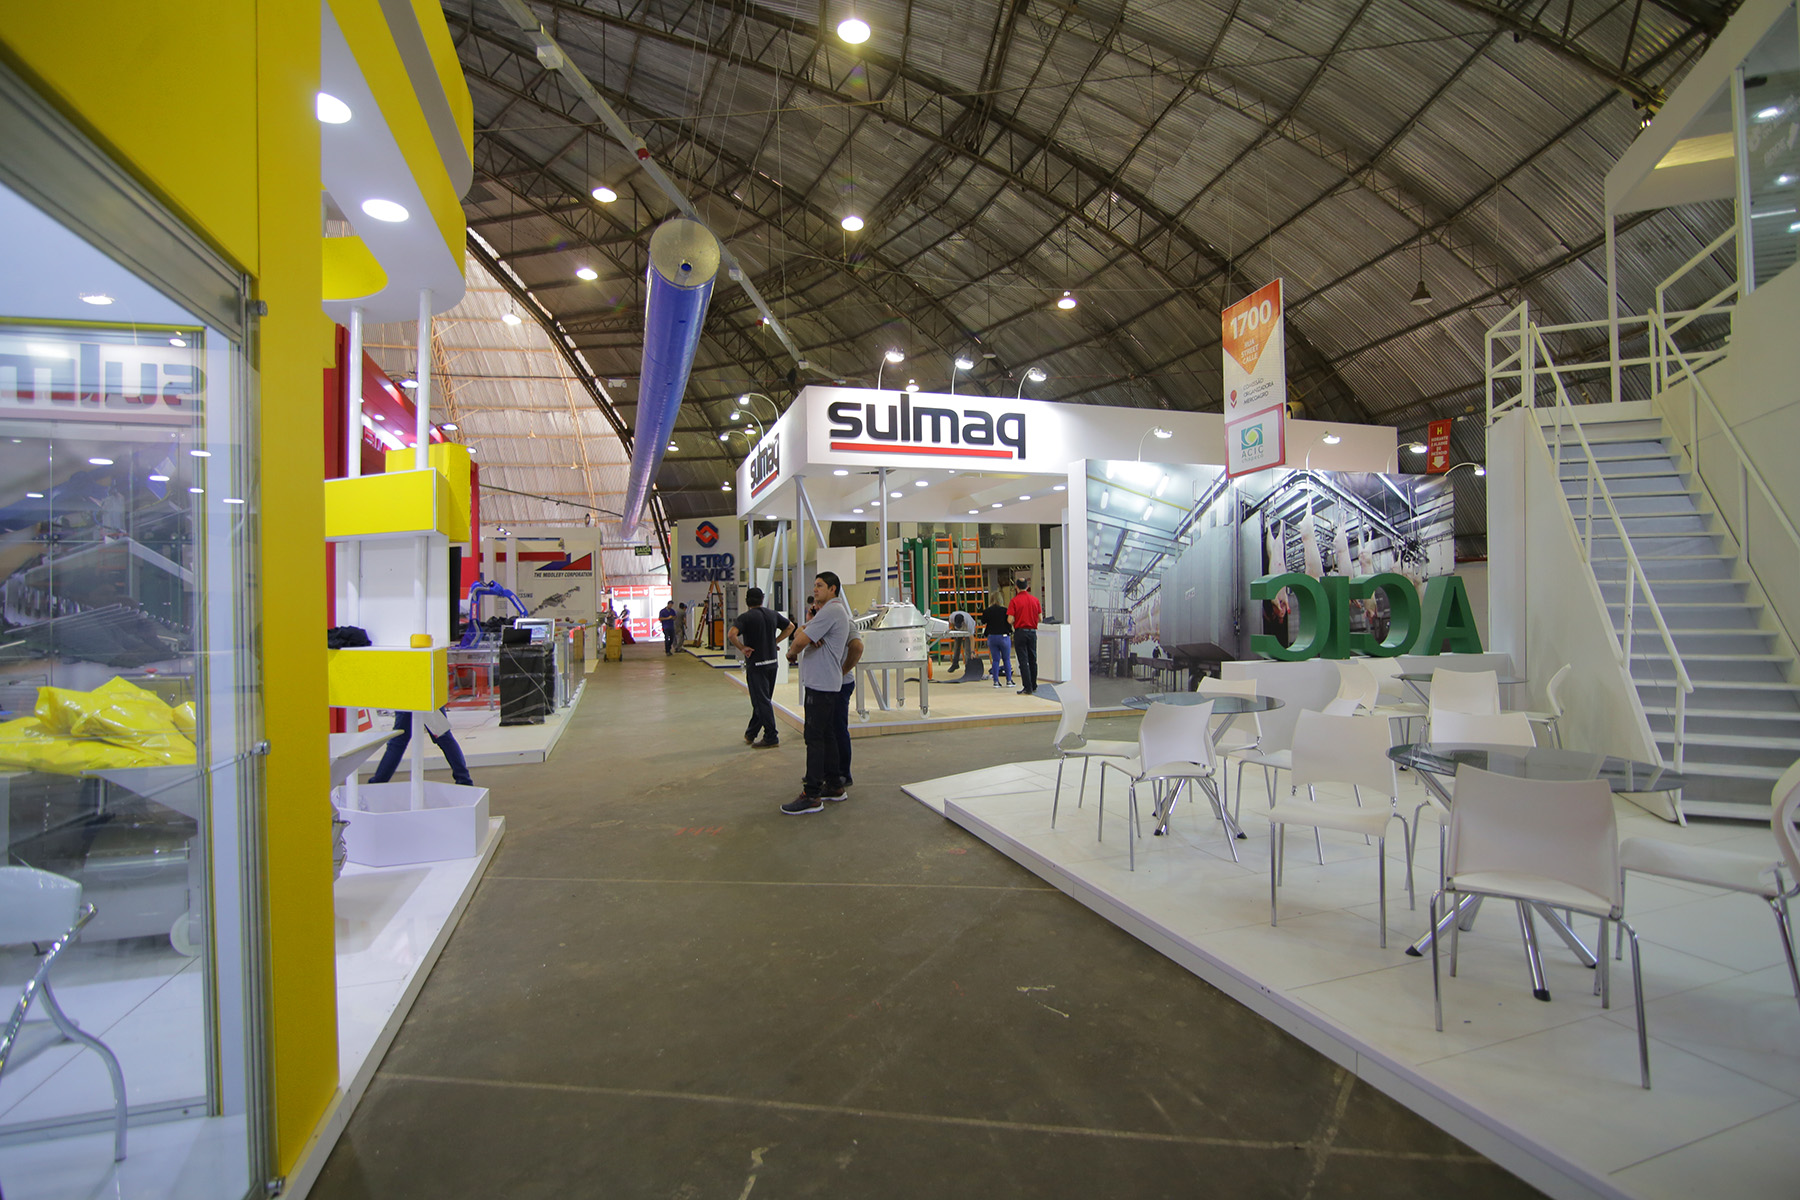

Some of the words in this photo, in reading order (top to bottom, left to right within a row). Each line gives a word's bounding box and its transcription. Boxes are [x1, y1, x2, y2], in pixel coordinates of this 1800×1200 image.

[1230, 299, 1271, 340] 1700
[1241, 344, 1259, 358] STREET
[1242, 352, 1259, 365] CALLE
[1243, 381, 1274, 397] ORGANIZADORA
[1243, 391, 1269, 404] MERCOAGRO
[828, 393, 1026, 460] sulmaq
[1437, 426, 1443, 435] H
[1241, 445, 1264, 458] ACIC
[750, 432, 780, 490] sulmaq
[681, 553, 735, 568] ELETRO
[681, 567, 735, 582] SERVICE
